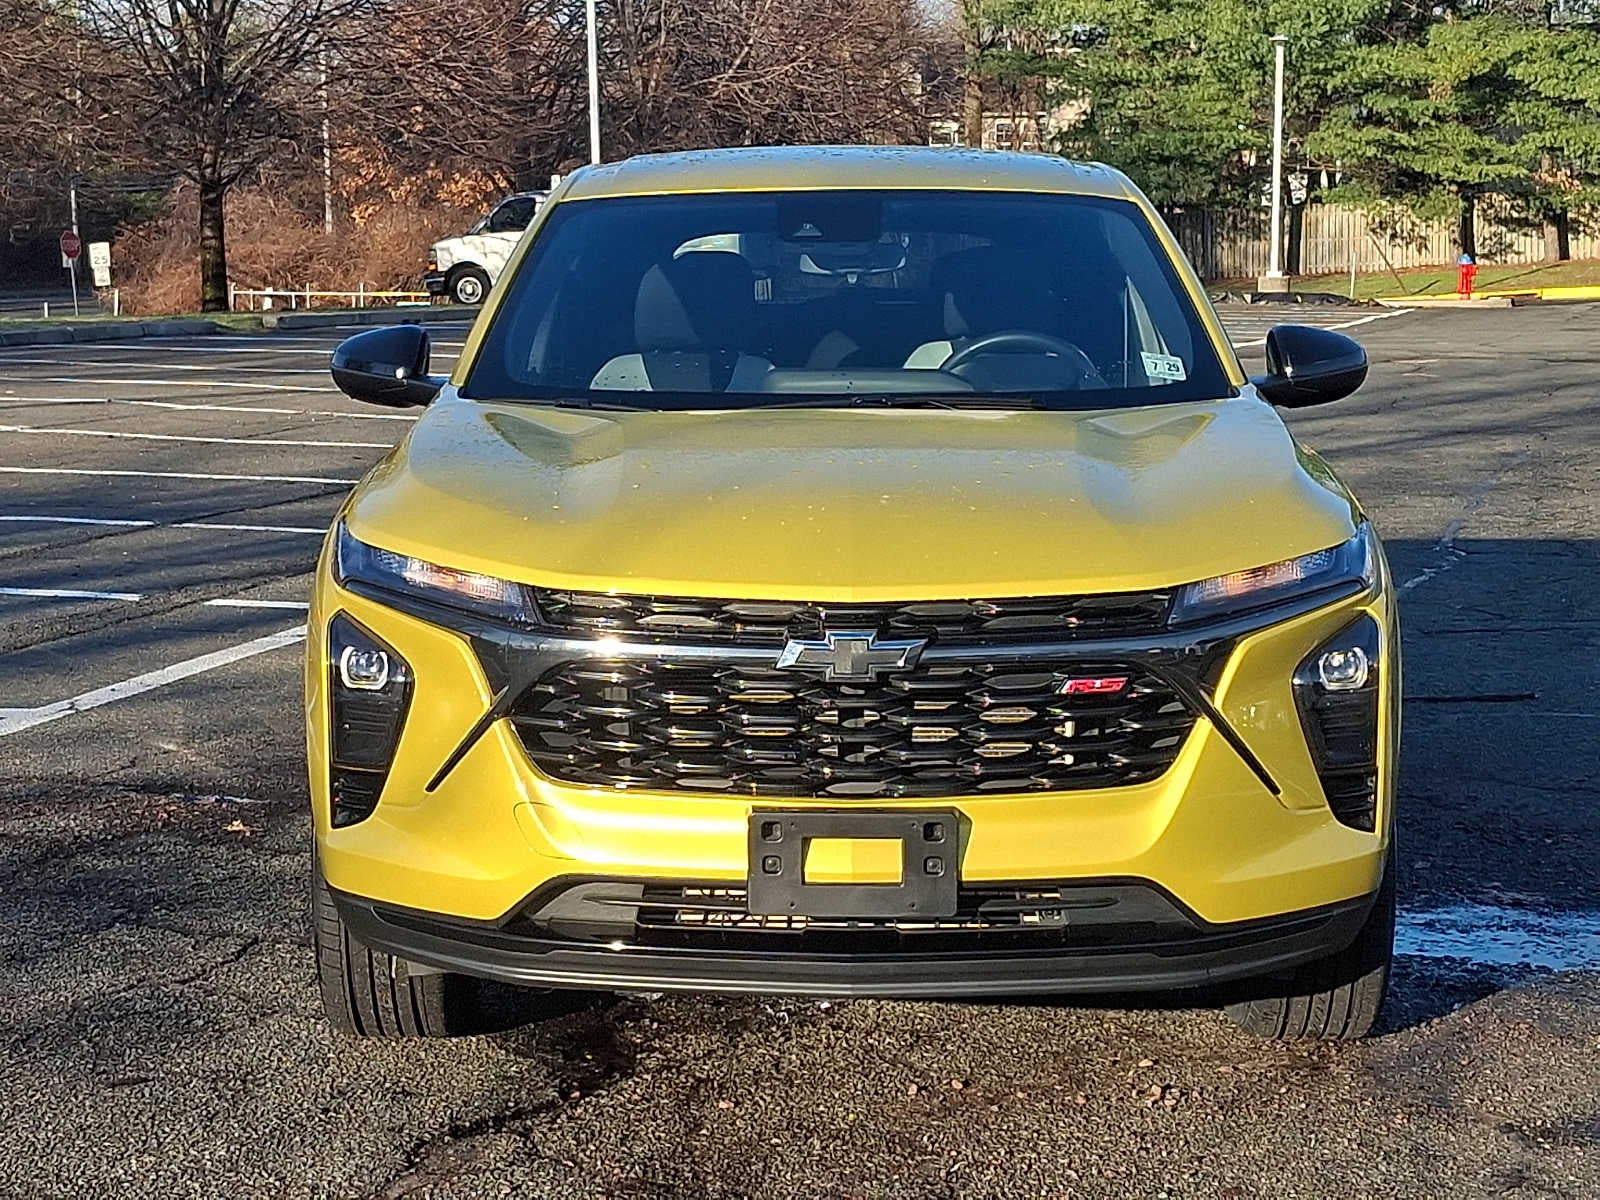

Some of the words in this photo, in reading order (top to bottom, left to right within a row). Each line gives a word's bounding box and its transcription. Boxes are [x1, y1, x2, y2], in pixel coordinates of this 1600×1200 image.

[94, 255, 108, 265] 25
[1151, 361, 1158, 371] 7
[1165, 361, 1180, 372] 29
[1060, 677, 1128, 694] RS
